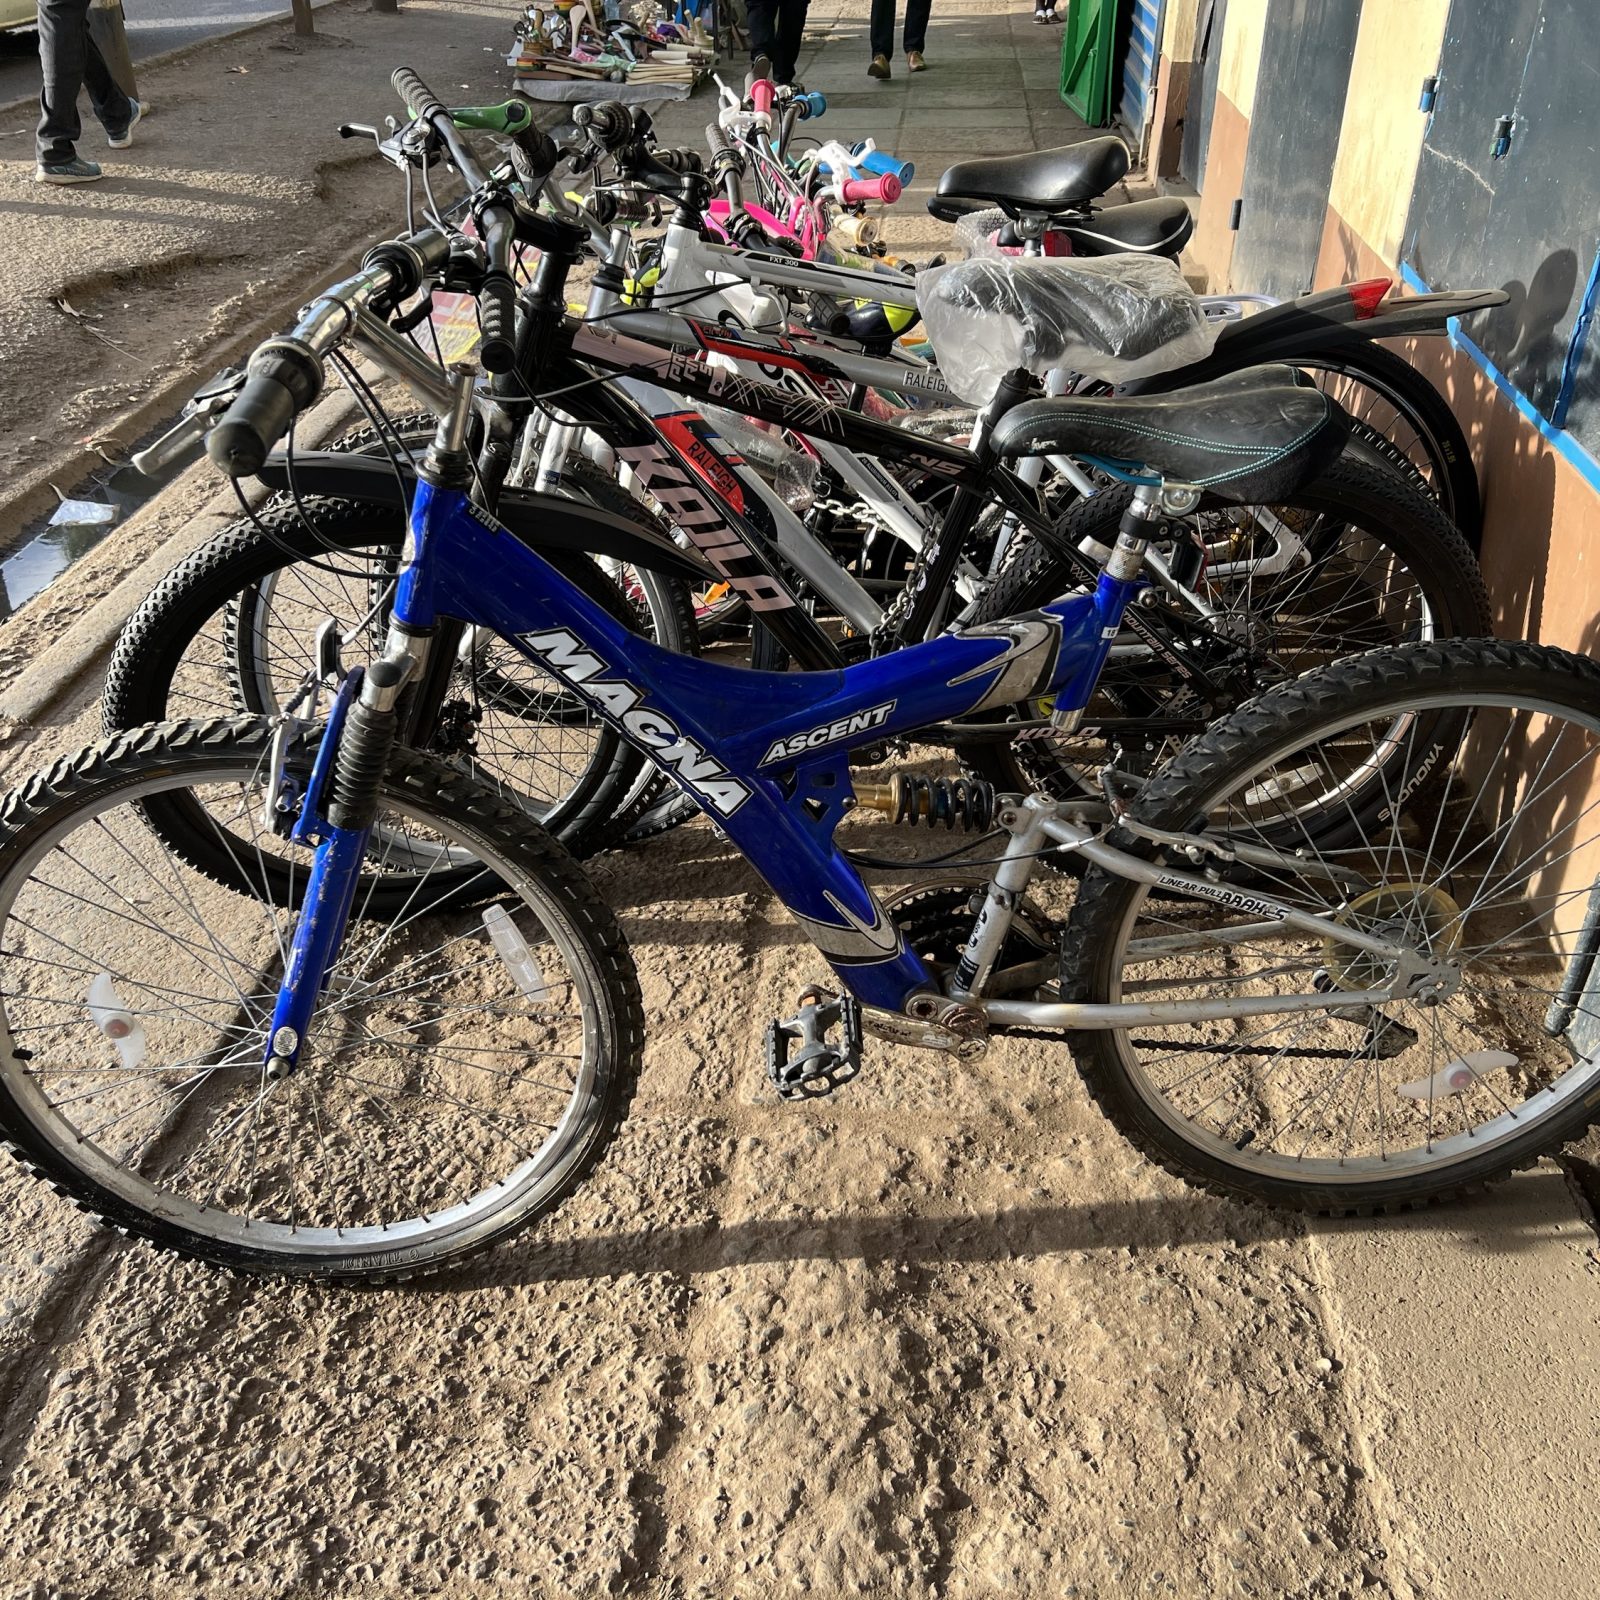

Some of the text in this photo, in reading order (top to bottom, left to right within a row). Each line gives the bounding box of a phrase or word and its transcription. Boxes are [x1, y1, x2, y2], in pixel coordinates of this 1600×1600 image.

[769, 256, 799, 267] FXT 300
[687, 440, 738, 495] RALEIGH
[516, 627, 752, 817] MAGNA
[760, 702, 895, 766] ASCENT
[1159, 876, 1198, 892] LINEAR
[1197, 886, 1223, 899] PULL
